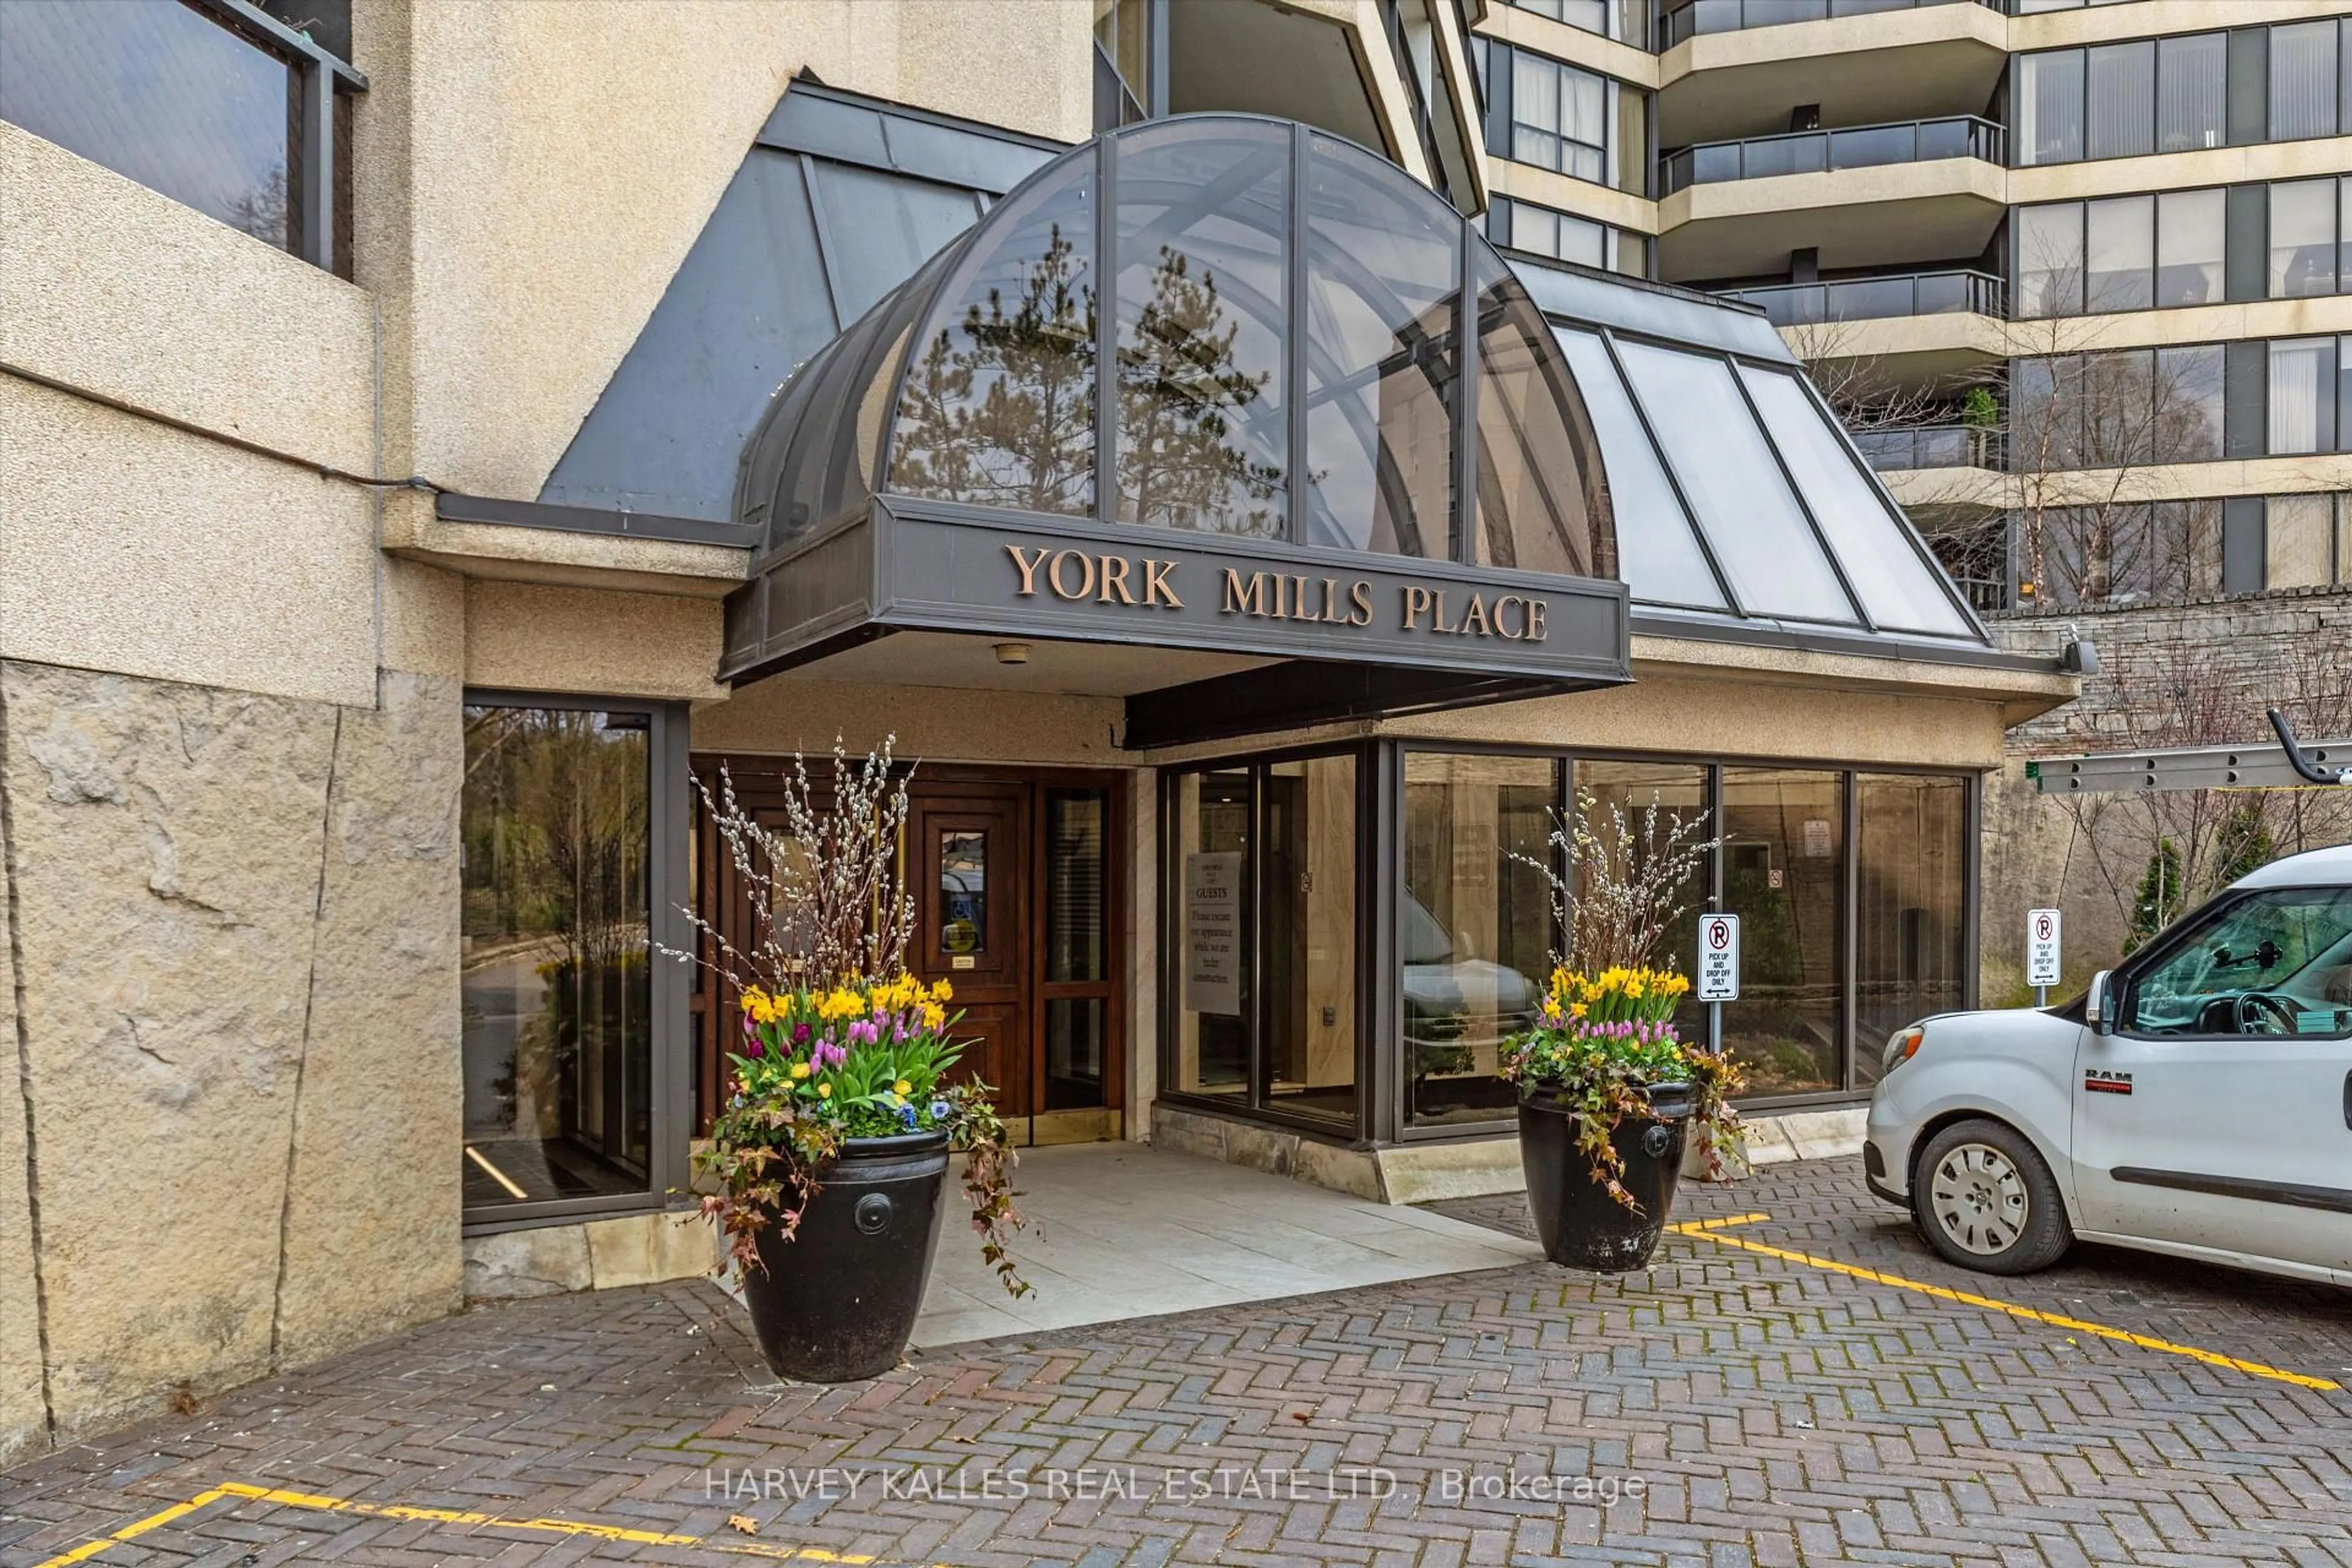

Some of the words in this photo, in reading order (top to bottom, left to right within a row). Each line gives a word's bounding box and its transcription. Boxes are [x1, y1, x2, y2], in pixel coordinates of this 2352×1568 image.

[1005, 545, 1185, 608] YORK
[1221, 567, 1373, 627] MILLS
[1403, 586, 1548, 641] PLACE
[1196, 887, 1227, 899] GUESTS
[2086, 1069, 2132, 1082] RAM
